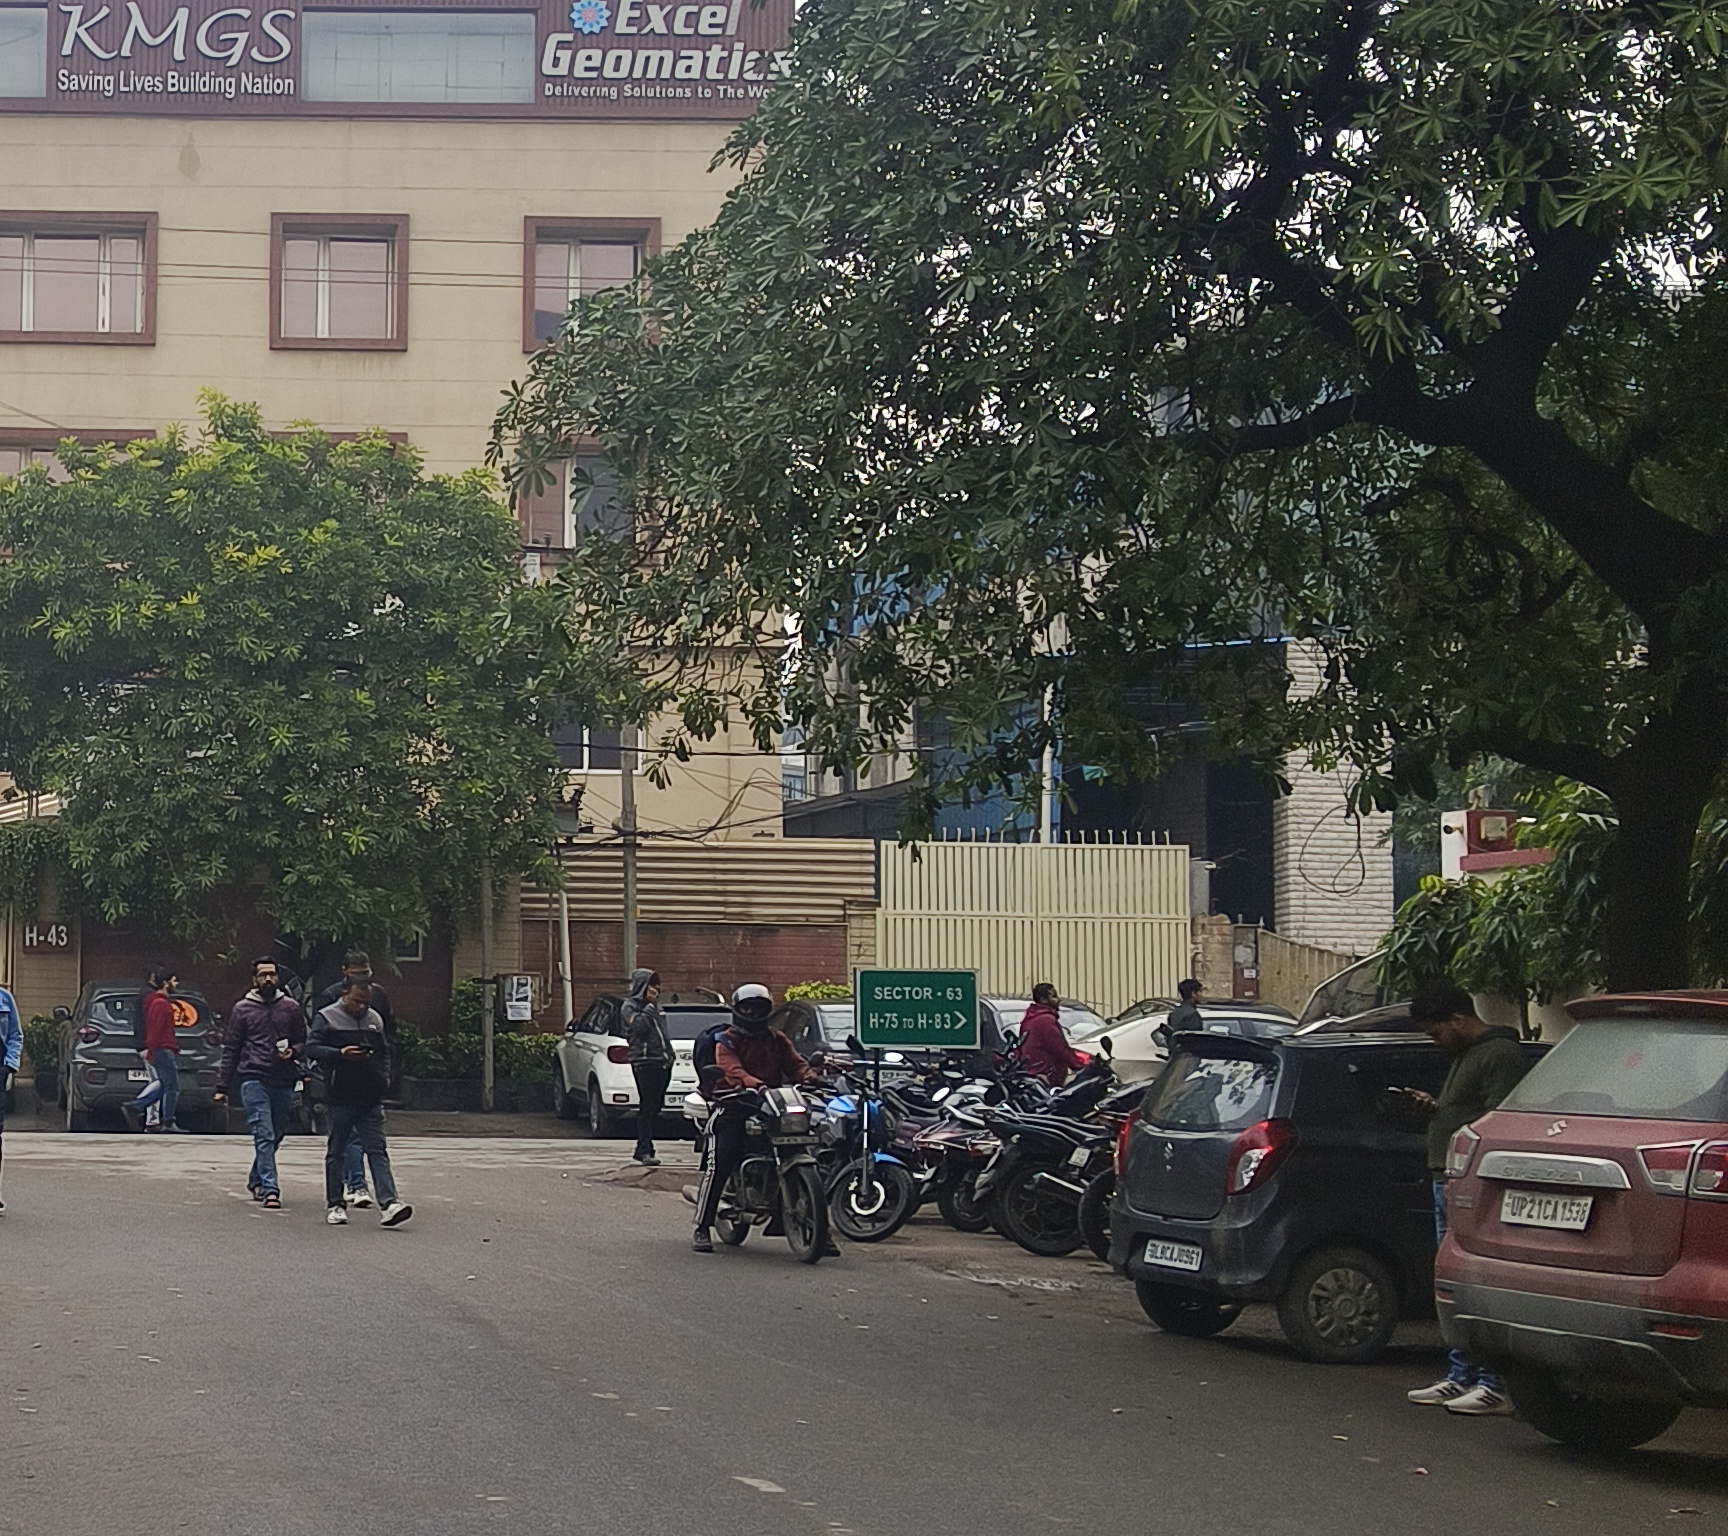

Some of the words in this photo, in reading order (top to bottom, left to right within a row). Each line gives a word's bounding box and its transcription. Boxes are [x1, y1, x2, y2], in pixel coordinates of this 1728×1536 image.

[59, 1, 296, 67] KMGS
[57, 69, 115, 96] Saving
[119, 70, 164, 93] Lives
[167, 71, 236, 99] Building
[240, 72, 294, 95] Nation
[544, 82, 618, 100] Delivering
[623, 83, 692, 99] Solutions
[697, 85, 712, 98] to
[717, 85, 745, 99] The
[25, 925, 88, 948] H-43
[873, 986, 933, 1000] SECTOR
[946, 987, 963, 1001] 63
